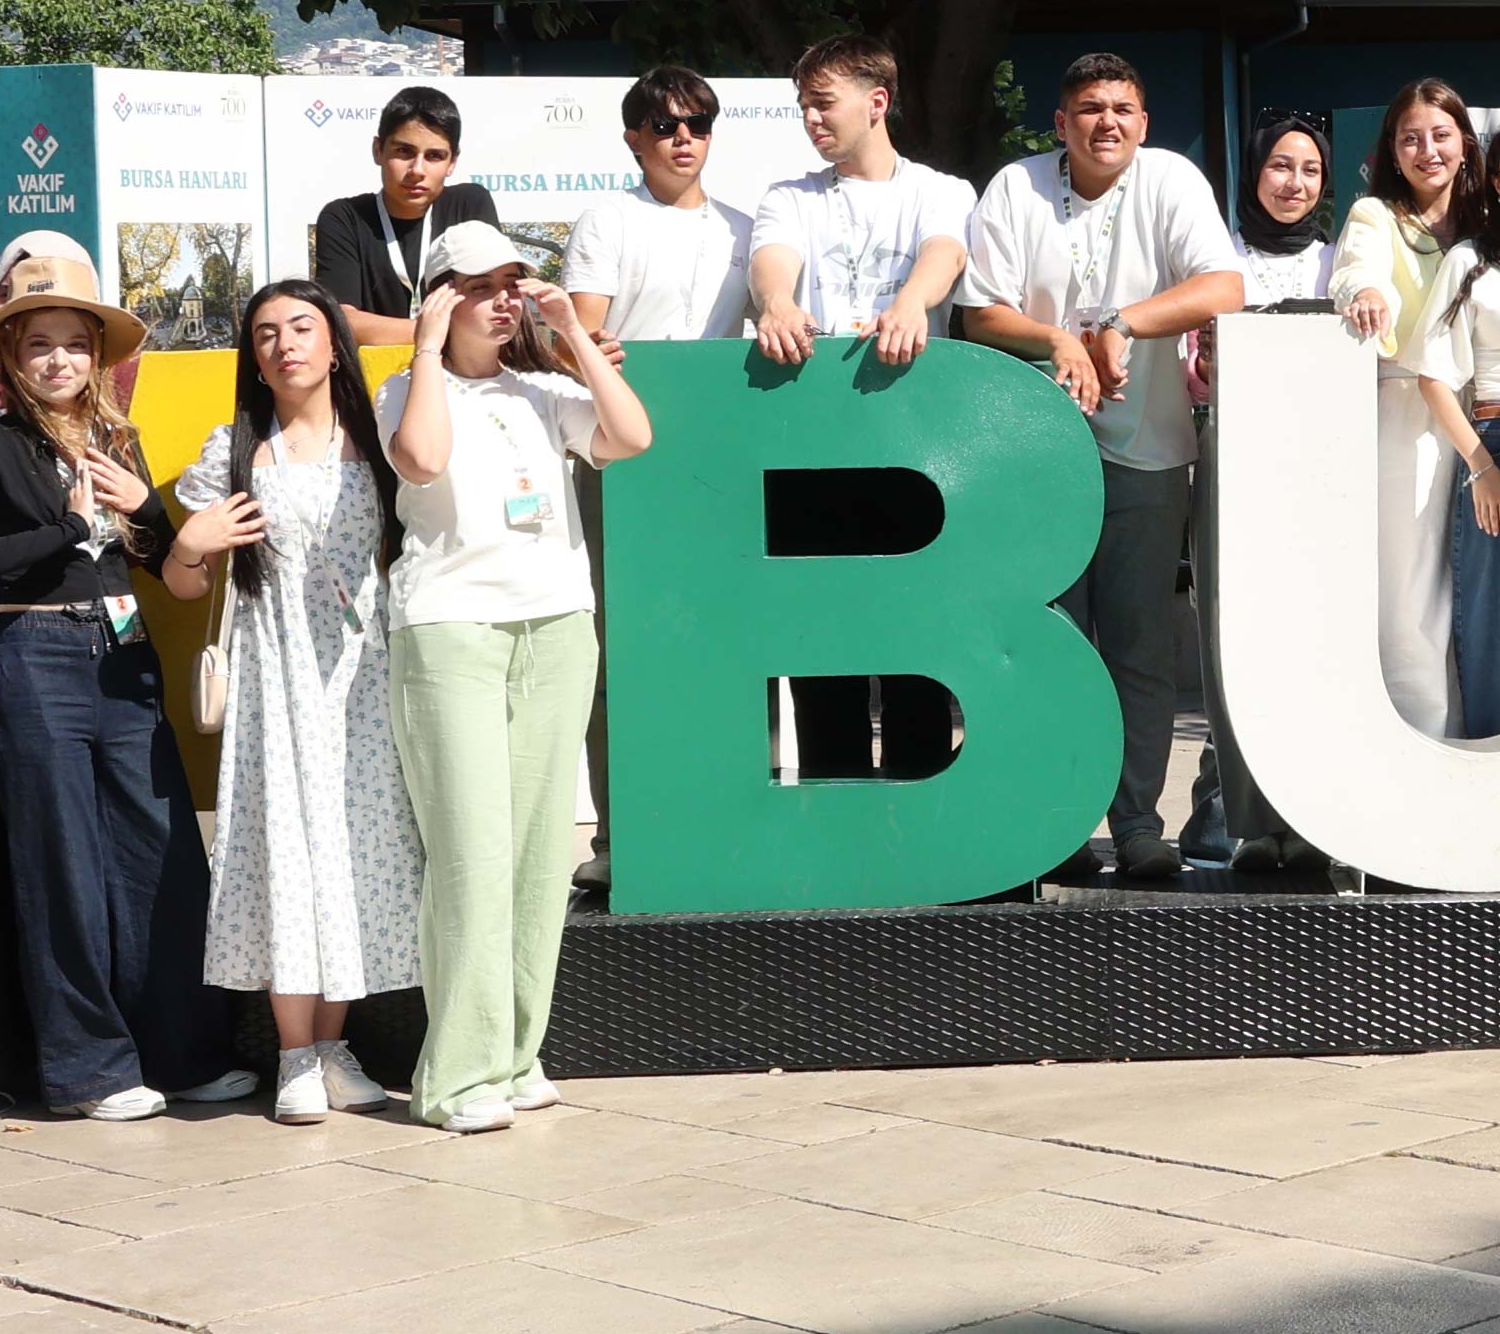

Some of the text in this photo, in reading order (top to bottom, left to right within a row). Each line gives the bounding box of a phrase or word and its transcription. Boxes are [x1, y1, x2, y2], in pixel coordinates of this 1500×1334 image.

[135, 102, 201, 116] VAKIF KATILIM
[220, 97, 246, 116] 700
[337, 108, 378, 120] VAKIF
[543, 105, 584, 123] 700
[723, 107, 803, 119] VAKIF KATIL
[17, 174, 64, 192] VAKIF
[120, 169, 248, 189] BURSA HANLARI
[470, 173, 645, 191] BURSA HANLA
[8, 195, 75, 213] KATILIM
[519, 478, 530, 490] 2
